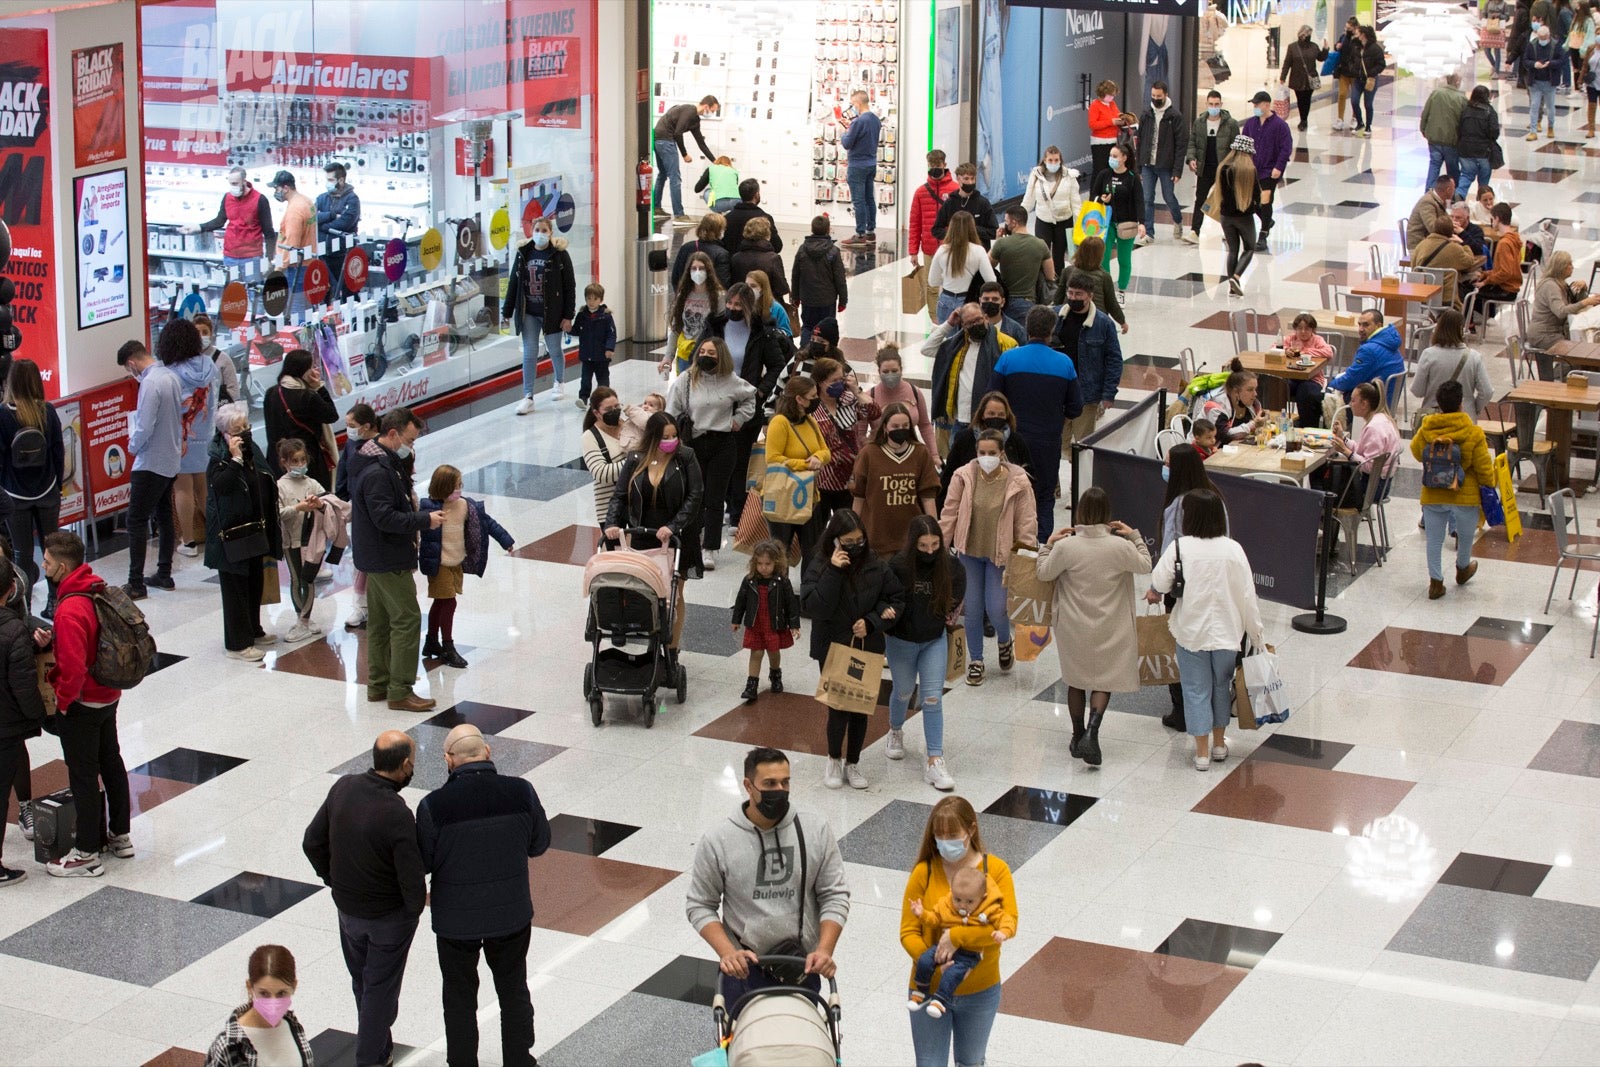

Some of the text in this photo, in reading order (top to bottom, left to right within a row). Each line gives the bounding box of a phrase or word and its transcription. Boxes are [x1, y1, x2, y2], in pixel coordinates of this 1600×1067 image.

[521, 8, 575, 41] VIERNES
[528, 40, 568, 58] BLACK
[1074, 35, 1096, 49] SHOPPING
[78, 48, 114, 77] BLACK
[528, 55, 568, 71] FRIDAY
[77, 68, 113, 96] FRIDAY
[271, 59, 409, 92] Auriculares
[100, 200, 120, 210] importa
[13, 247, 42, 258] aquí los
[386, 253, 404, 267] yoigo
[223, 299, 246, 311] simyo
[91, 403, 99, 411] Por
[104, 395, 124, 407] seguridad
[99, 420, 122, 433] necesario
[880, 475, 916, 493] Toge
[886, 490, 917, 506] ther
[752, 887, 795, 900] Bulevip
